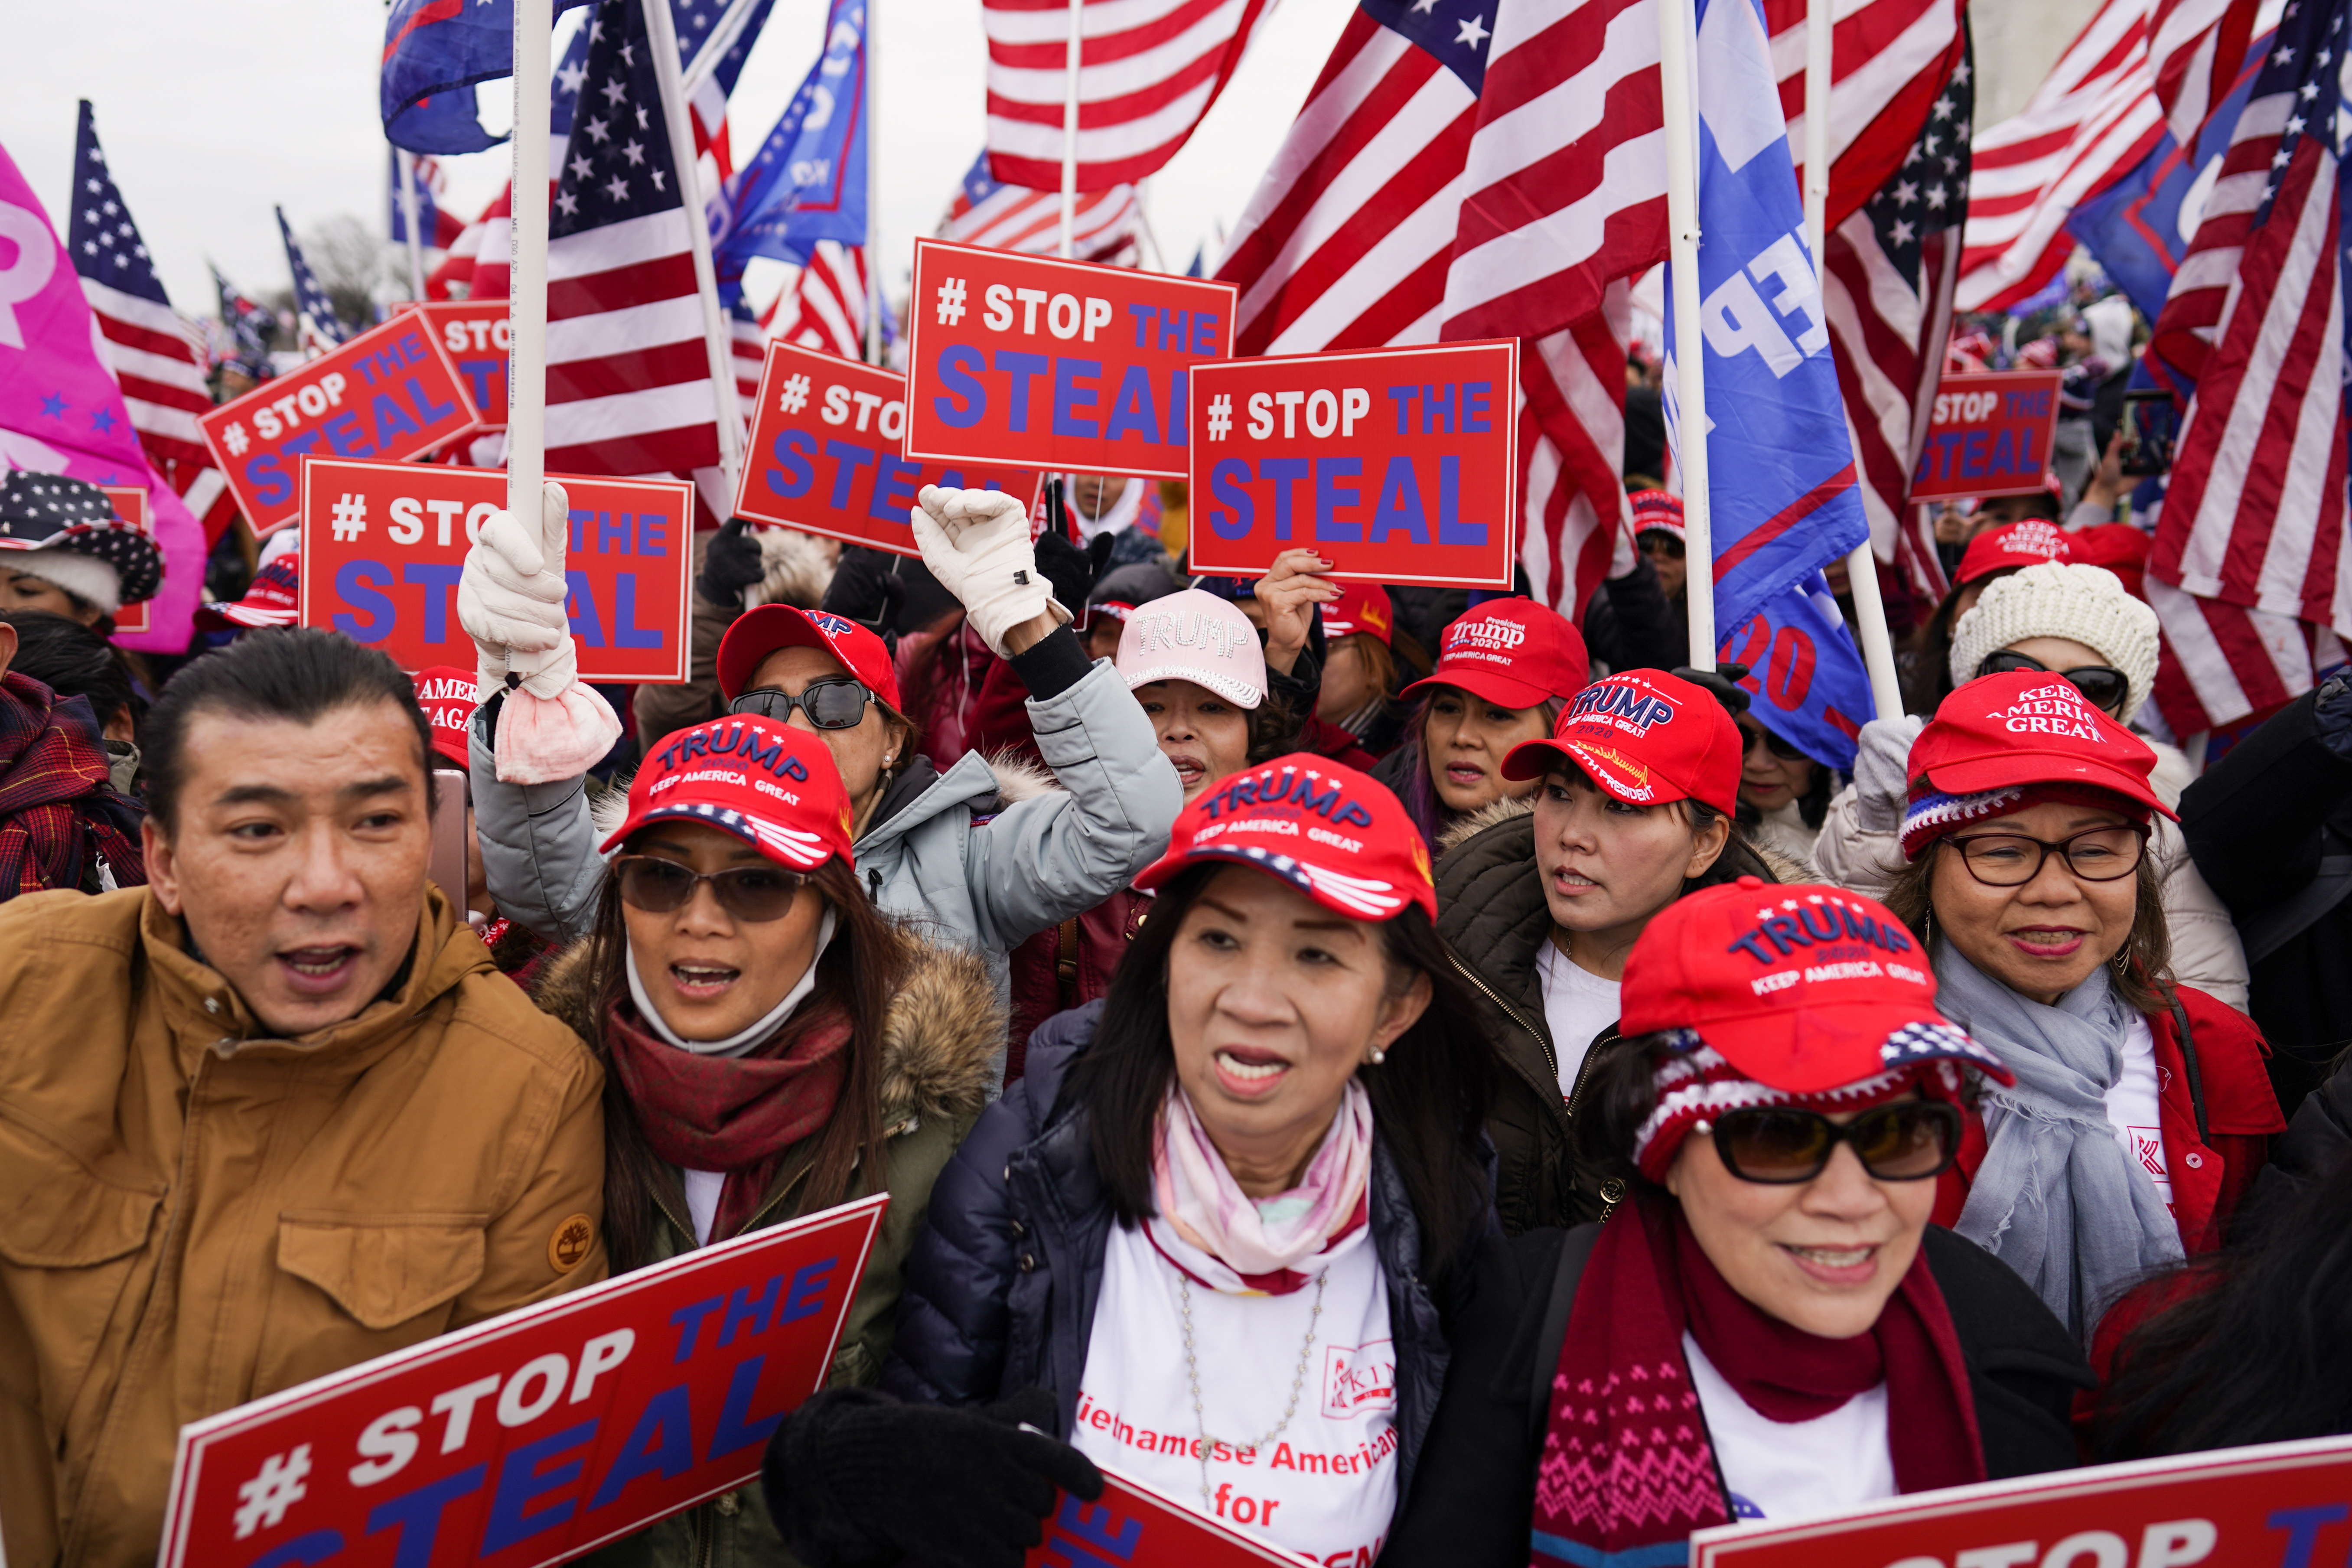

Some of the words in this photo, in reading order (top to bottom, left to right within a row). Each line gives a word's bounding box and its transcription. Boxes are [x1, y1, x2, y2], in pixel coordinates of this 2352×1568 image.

[444, 319, 510, 352] STO
[937, 277, 968, 326] #
[983, 284, 1112, 342] STOP
[1128, 303, 1218, 357] THE
[253, 372, 347, 440] STOP
[352, 333, 427, 385] THE
[1932, 391, 1999, 425] STOP
[2005, 390, 2052, 418] THE
[820, 385, 906, 441] STO
[1207, 394, 1232, 442] #
[1247, 388, 1371, 440] STOP
[1388, 381, 1492, 435] THE
[1209, 455, 1489, 546] STEAL
[332, 493, 367, 542] #
[567, 509, 668, 557] THE
[332, 559, 663, 649] STAL
[1485, 616, 1526, 632] President
[1136, 610, 1249, 658] TRUMP
[1450, 621, 1525, 649] Trump
[1471, 637, 1501, 650] 2020
[1443, 652, 1456, 662] KEEP
[1455, 651, 1485, 660] AMERICA
[1486, 654, 1512, 666] GREAT
[418, 678, 480, 705] AMER
[1568, 685, 1674, 730] TRUMP
[1566, 715, 1582, 727] KEEP
[1580, 714, 1613, 726] AMERICA
[1576, 725, 1613, 739] 2020
[1986, 700, 2108, 743] AMERICA
[2006, 717, 2100, 743] GREAT
[657, 727, 809, 782] TRUMP
[699, 758, 749, 771] 2020
[649, 775, 681, 796] KEEP
[682, 770, 746, 786] AMERICA
[755, 779, 801, 806] GREAT
[1200, 773, 1372, 827] TRUMP
[1599, 769, 1655, 801] PRESIDENT
[1192, 824, 1228, 845] KEEP
[1227, 819, 1300, 836] AMERICA
[1307, 827, 1364, 854] GREAT
[1728, 905, 1912, 964] TRUMP
[1751, 970, 1800, 996] KEEP
[1805, 961, 1883, 983] AMERICA
[670, 1258, 838, 1363] THE
[349, 1328, 635, 1487] STOP
[1077, 1390, 1256, 1466] ietnamese
[1215, 1483, 1279, 1527] for
